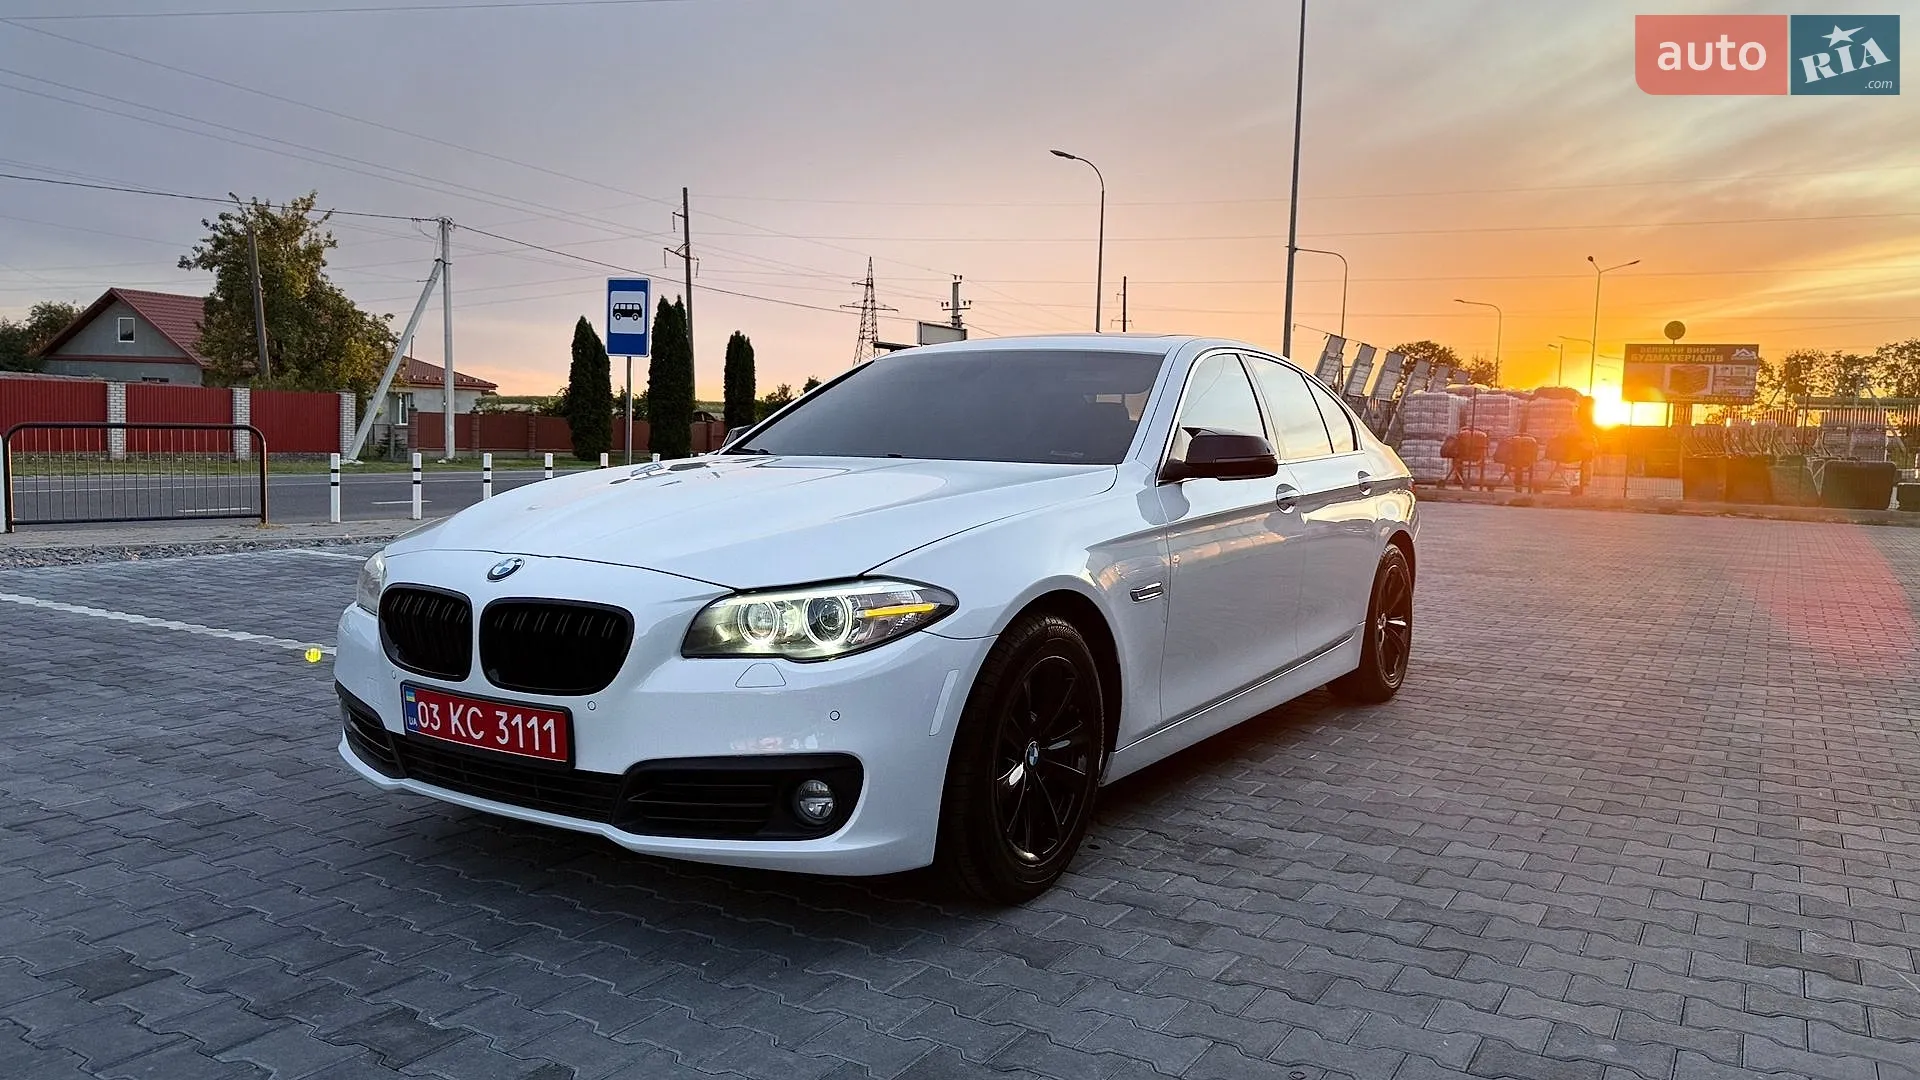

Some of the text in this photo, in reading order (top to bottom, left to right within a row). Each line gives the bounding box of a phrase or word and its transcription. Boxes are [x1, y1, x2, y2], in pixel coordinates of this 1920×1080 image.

[1631, 353, 1724, 362] БУДМАТЕРІАЛІВ
[408, 715, 418, 727] UA
[417, 701, 556, 753] 03 KC 3111
